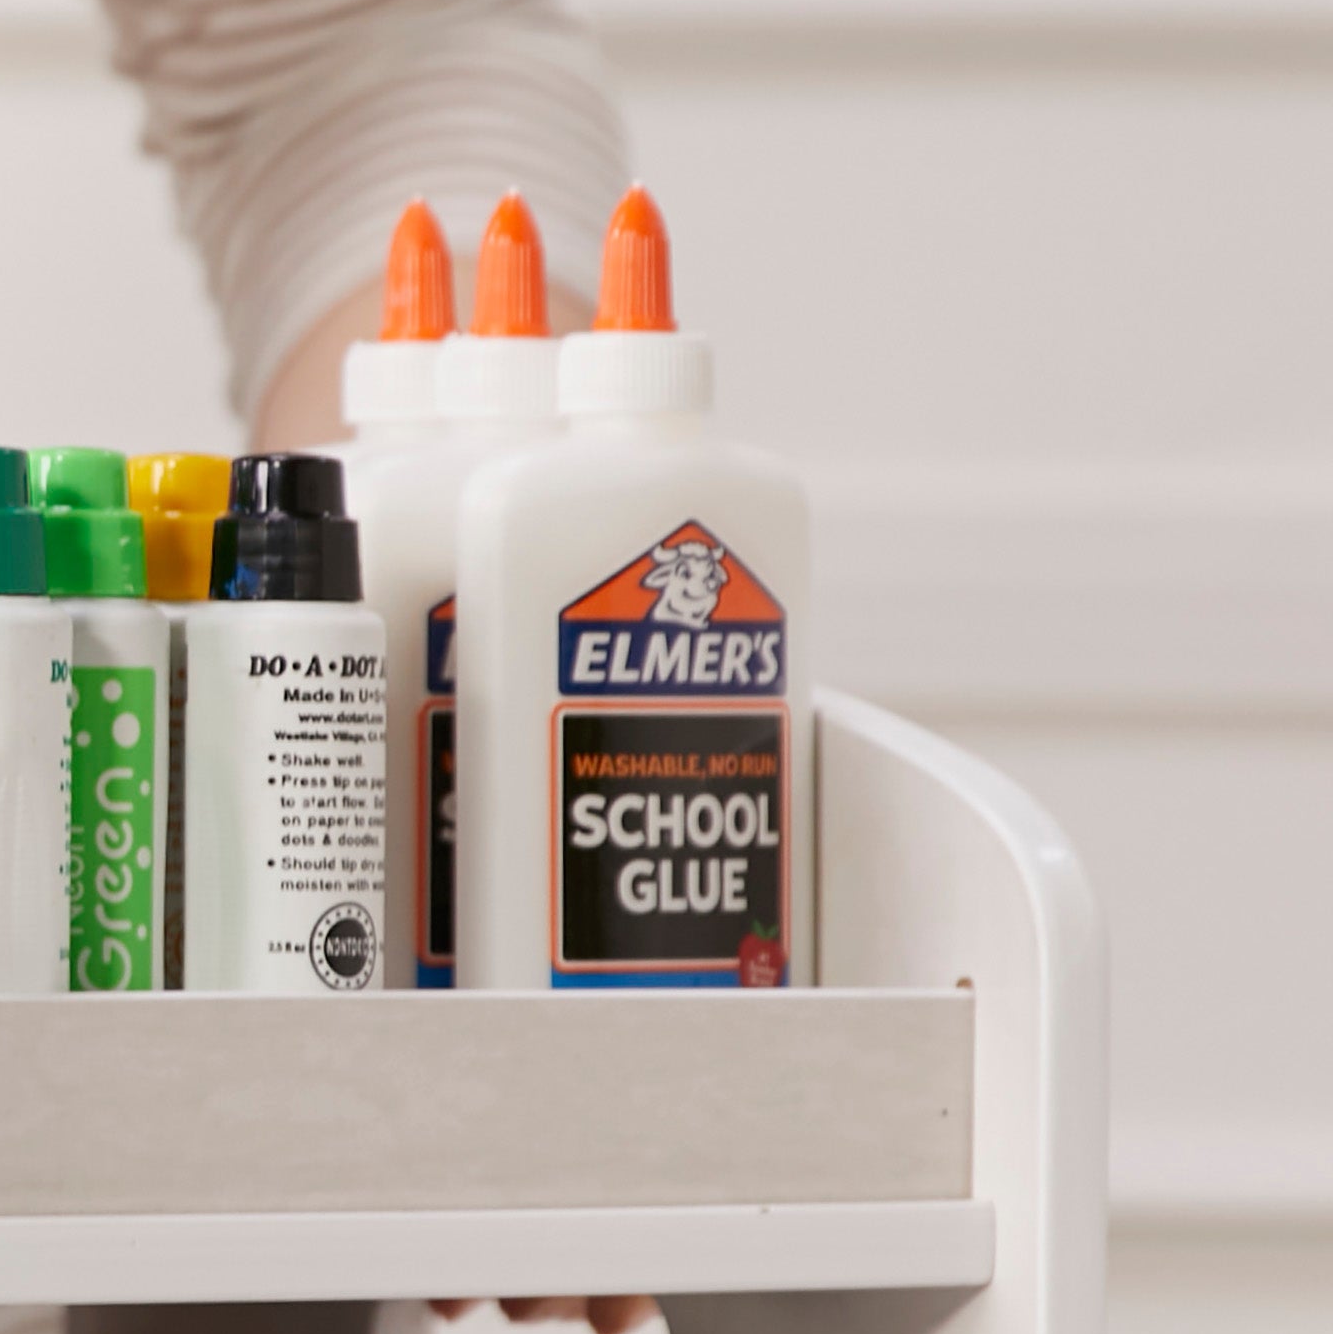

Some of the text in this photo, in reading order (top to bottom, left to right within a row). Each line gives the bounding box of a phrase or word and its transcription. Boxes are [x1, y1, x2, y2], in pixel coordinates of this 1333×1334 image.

[571, 630, 779, 685] ELMER'S
[250, 654, 287, 677] DO
[305, 655, 323, 678] A
[341, 656, 377, 678] DOT
[283, 687, 334, 703] Made
[340, 688, 354, 703] In
[283, 753, 332, 767] Shake
[572, 753, 777, 780] WASHABLE, NO RUN
[282, 774, 328, 788] Press
[281, 796, 295, 808] to
[302, 796, 337, 808] start
[281, 815, 301, 827] on
[307, 815, 350, 830] paper
[571, 792, 779, 849] SCHOOL
[281, 833, 316, 846] dots
[282, 857, 336, 871] Should
[77, 768, 133, 990] Green
[280, 879, 343, 892] moisten
[618, 857, 749, 914] GLUE
